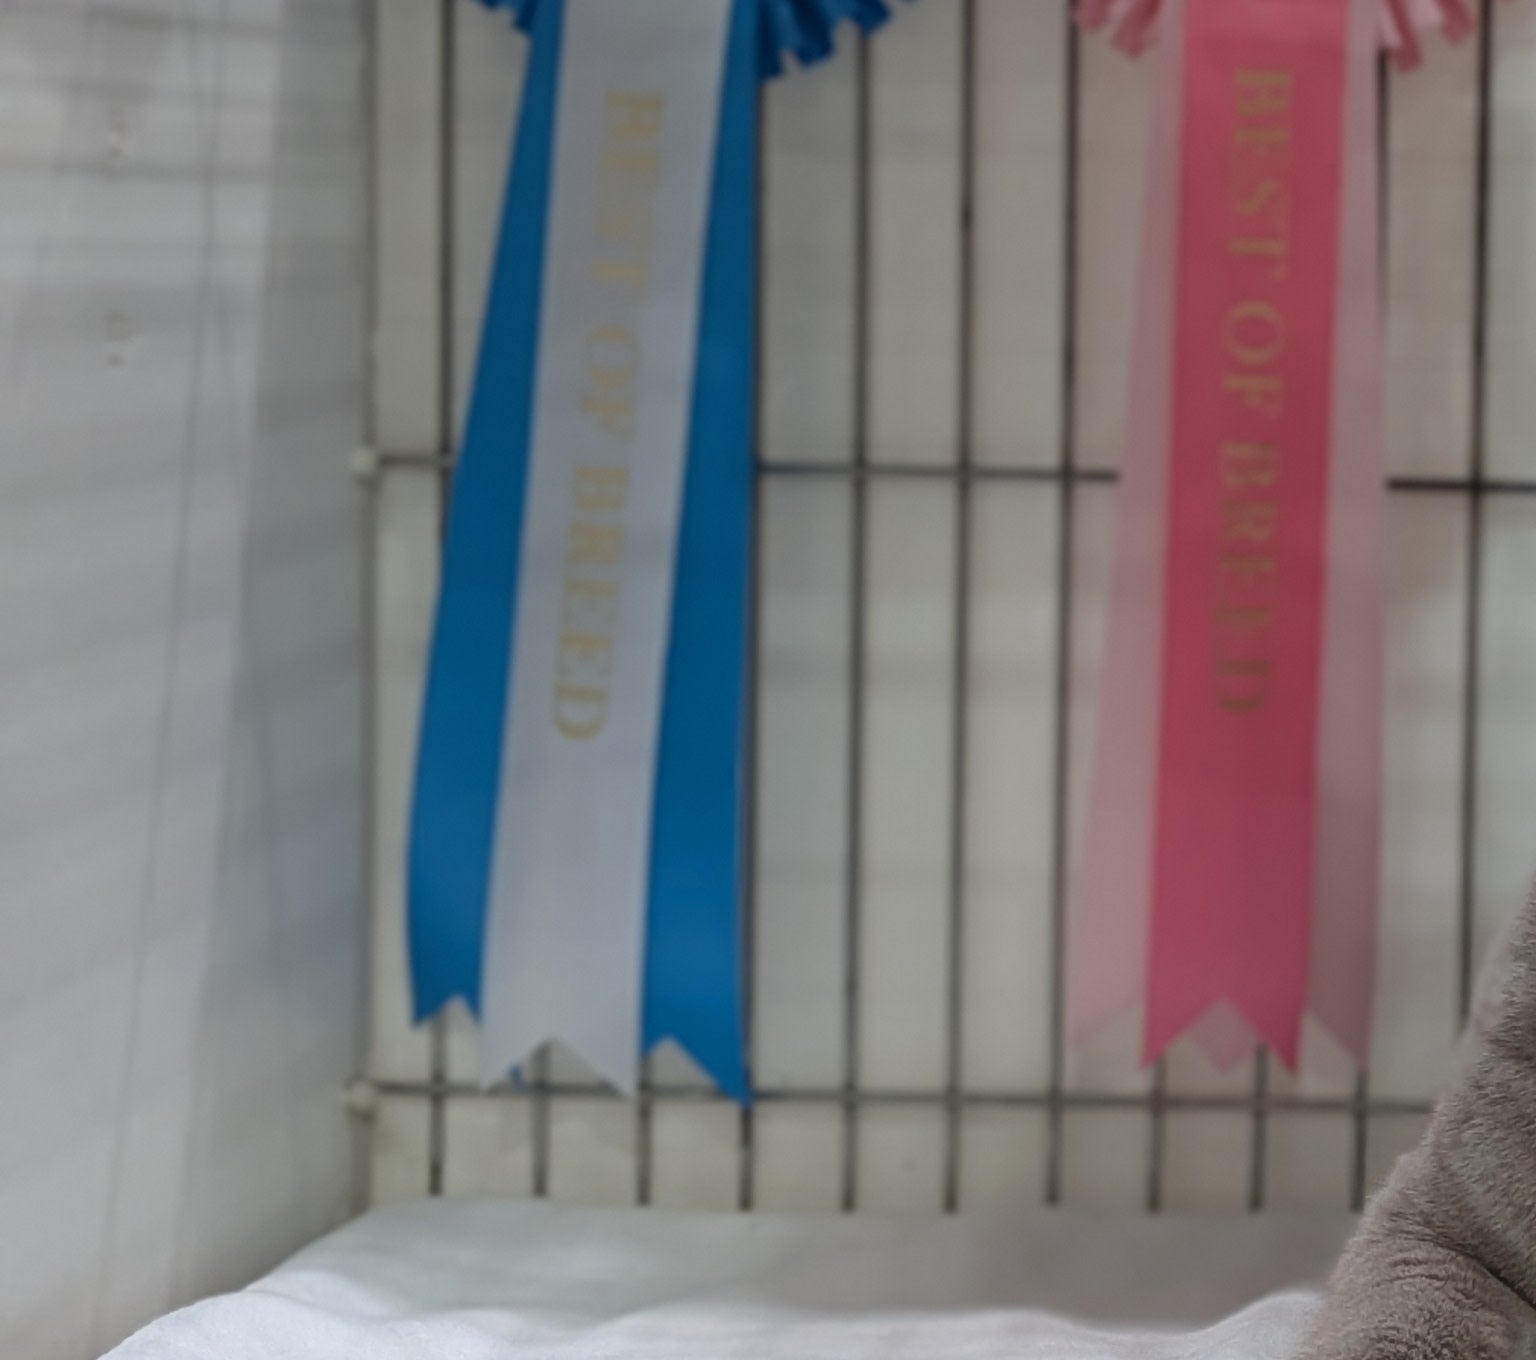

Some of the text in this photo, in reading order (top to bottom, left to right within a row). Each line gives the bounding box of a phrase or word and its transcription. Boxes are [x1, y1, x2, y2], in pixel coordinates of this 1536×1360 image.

[553, 87, 666, 740] BEST OF BREED
[1217, 68, 1292, 716] BEST OF BREED
